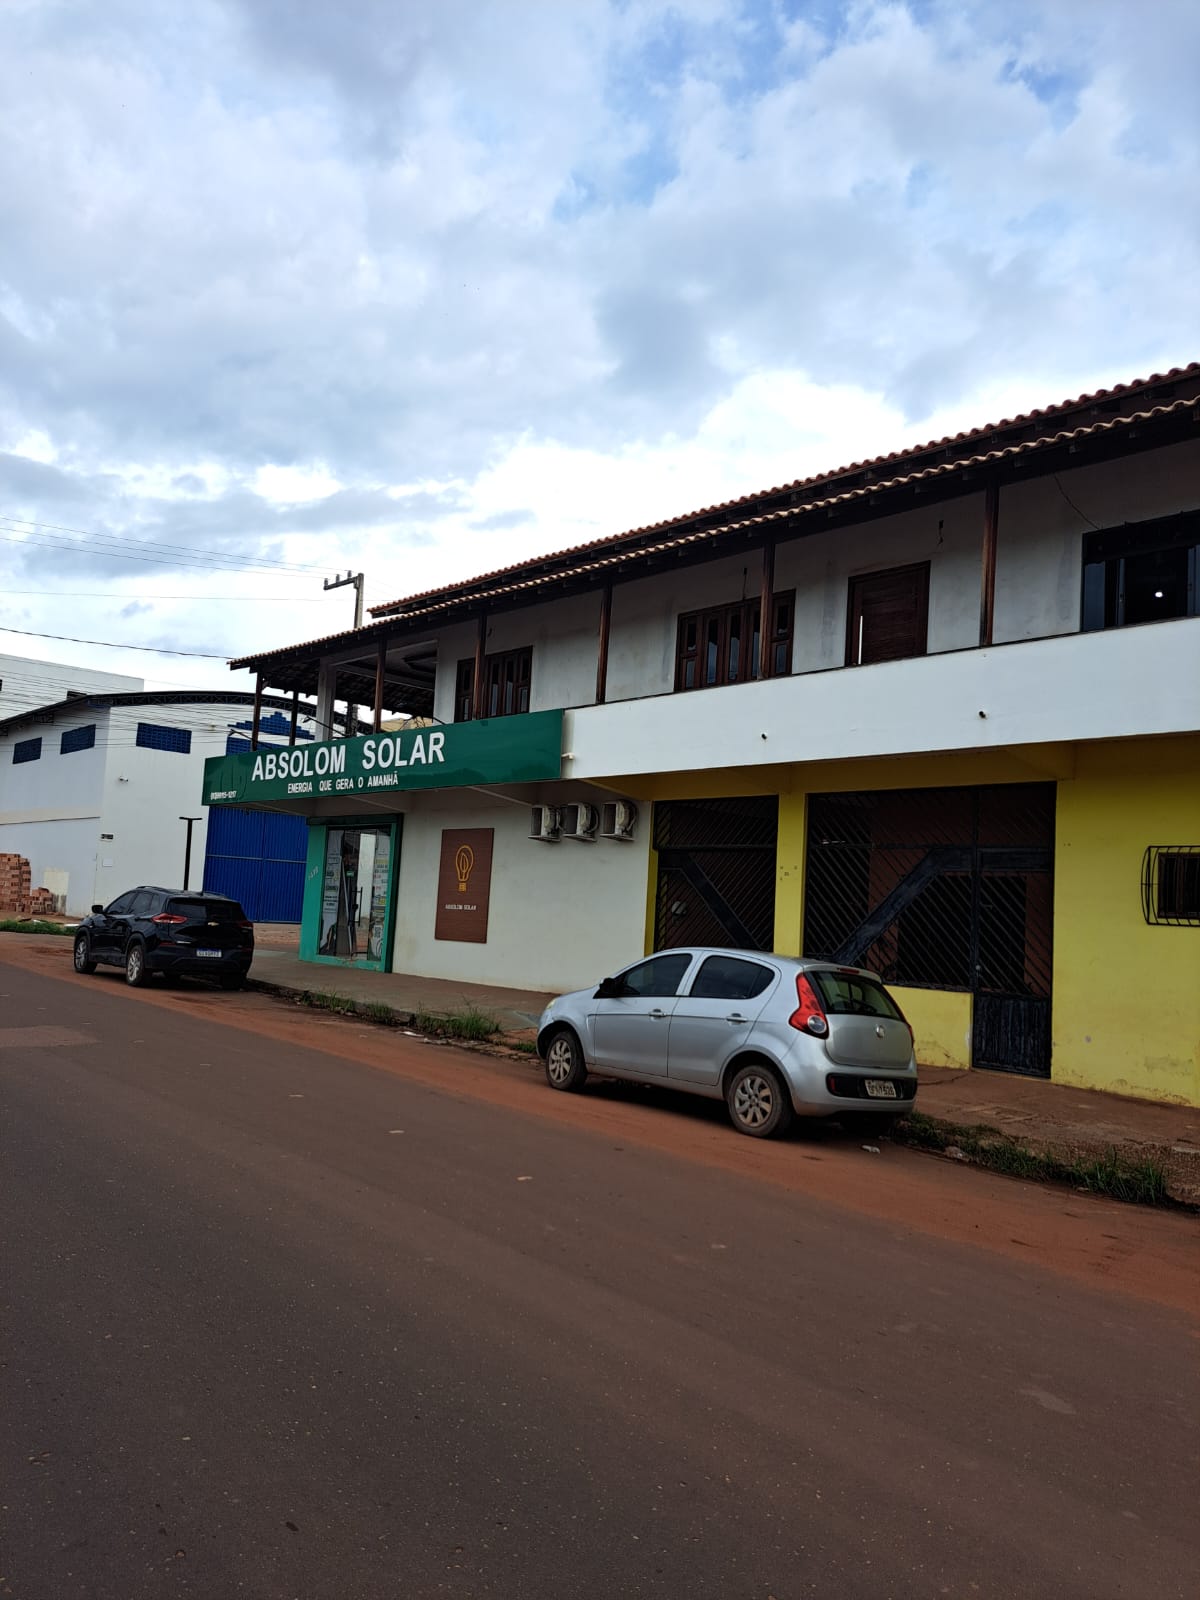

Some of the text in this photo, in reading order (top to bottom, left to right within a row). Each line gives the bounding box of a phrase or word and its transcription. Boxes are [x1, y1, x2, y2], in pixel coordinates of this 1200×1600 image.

[252, 732, 445, 781] ABSOLOM SOLAR
[288, 771, 398, 794] ENERGIA QUE GERA O AMANHÃ
